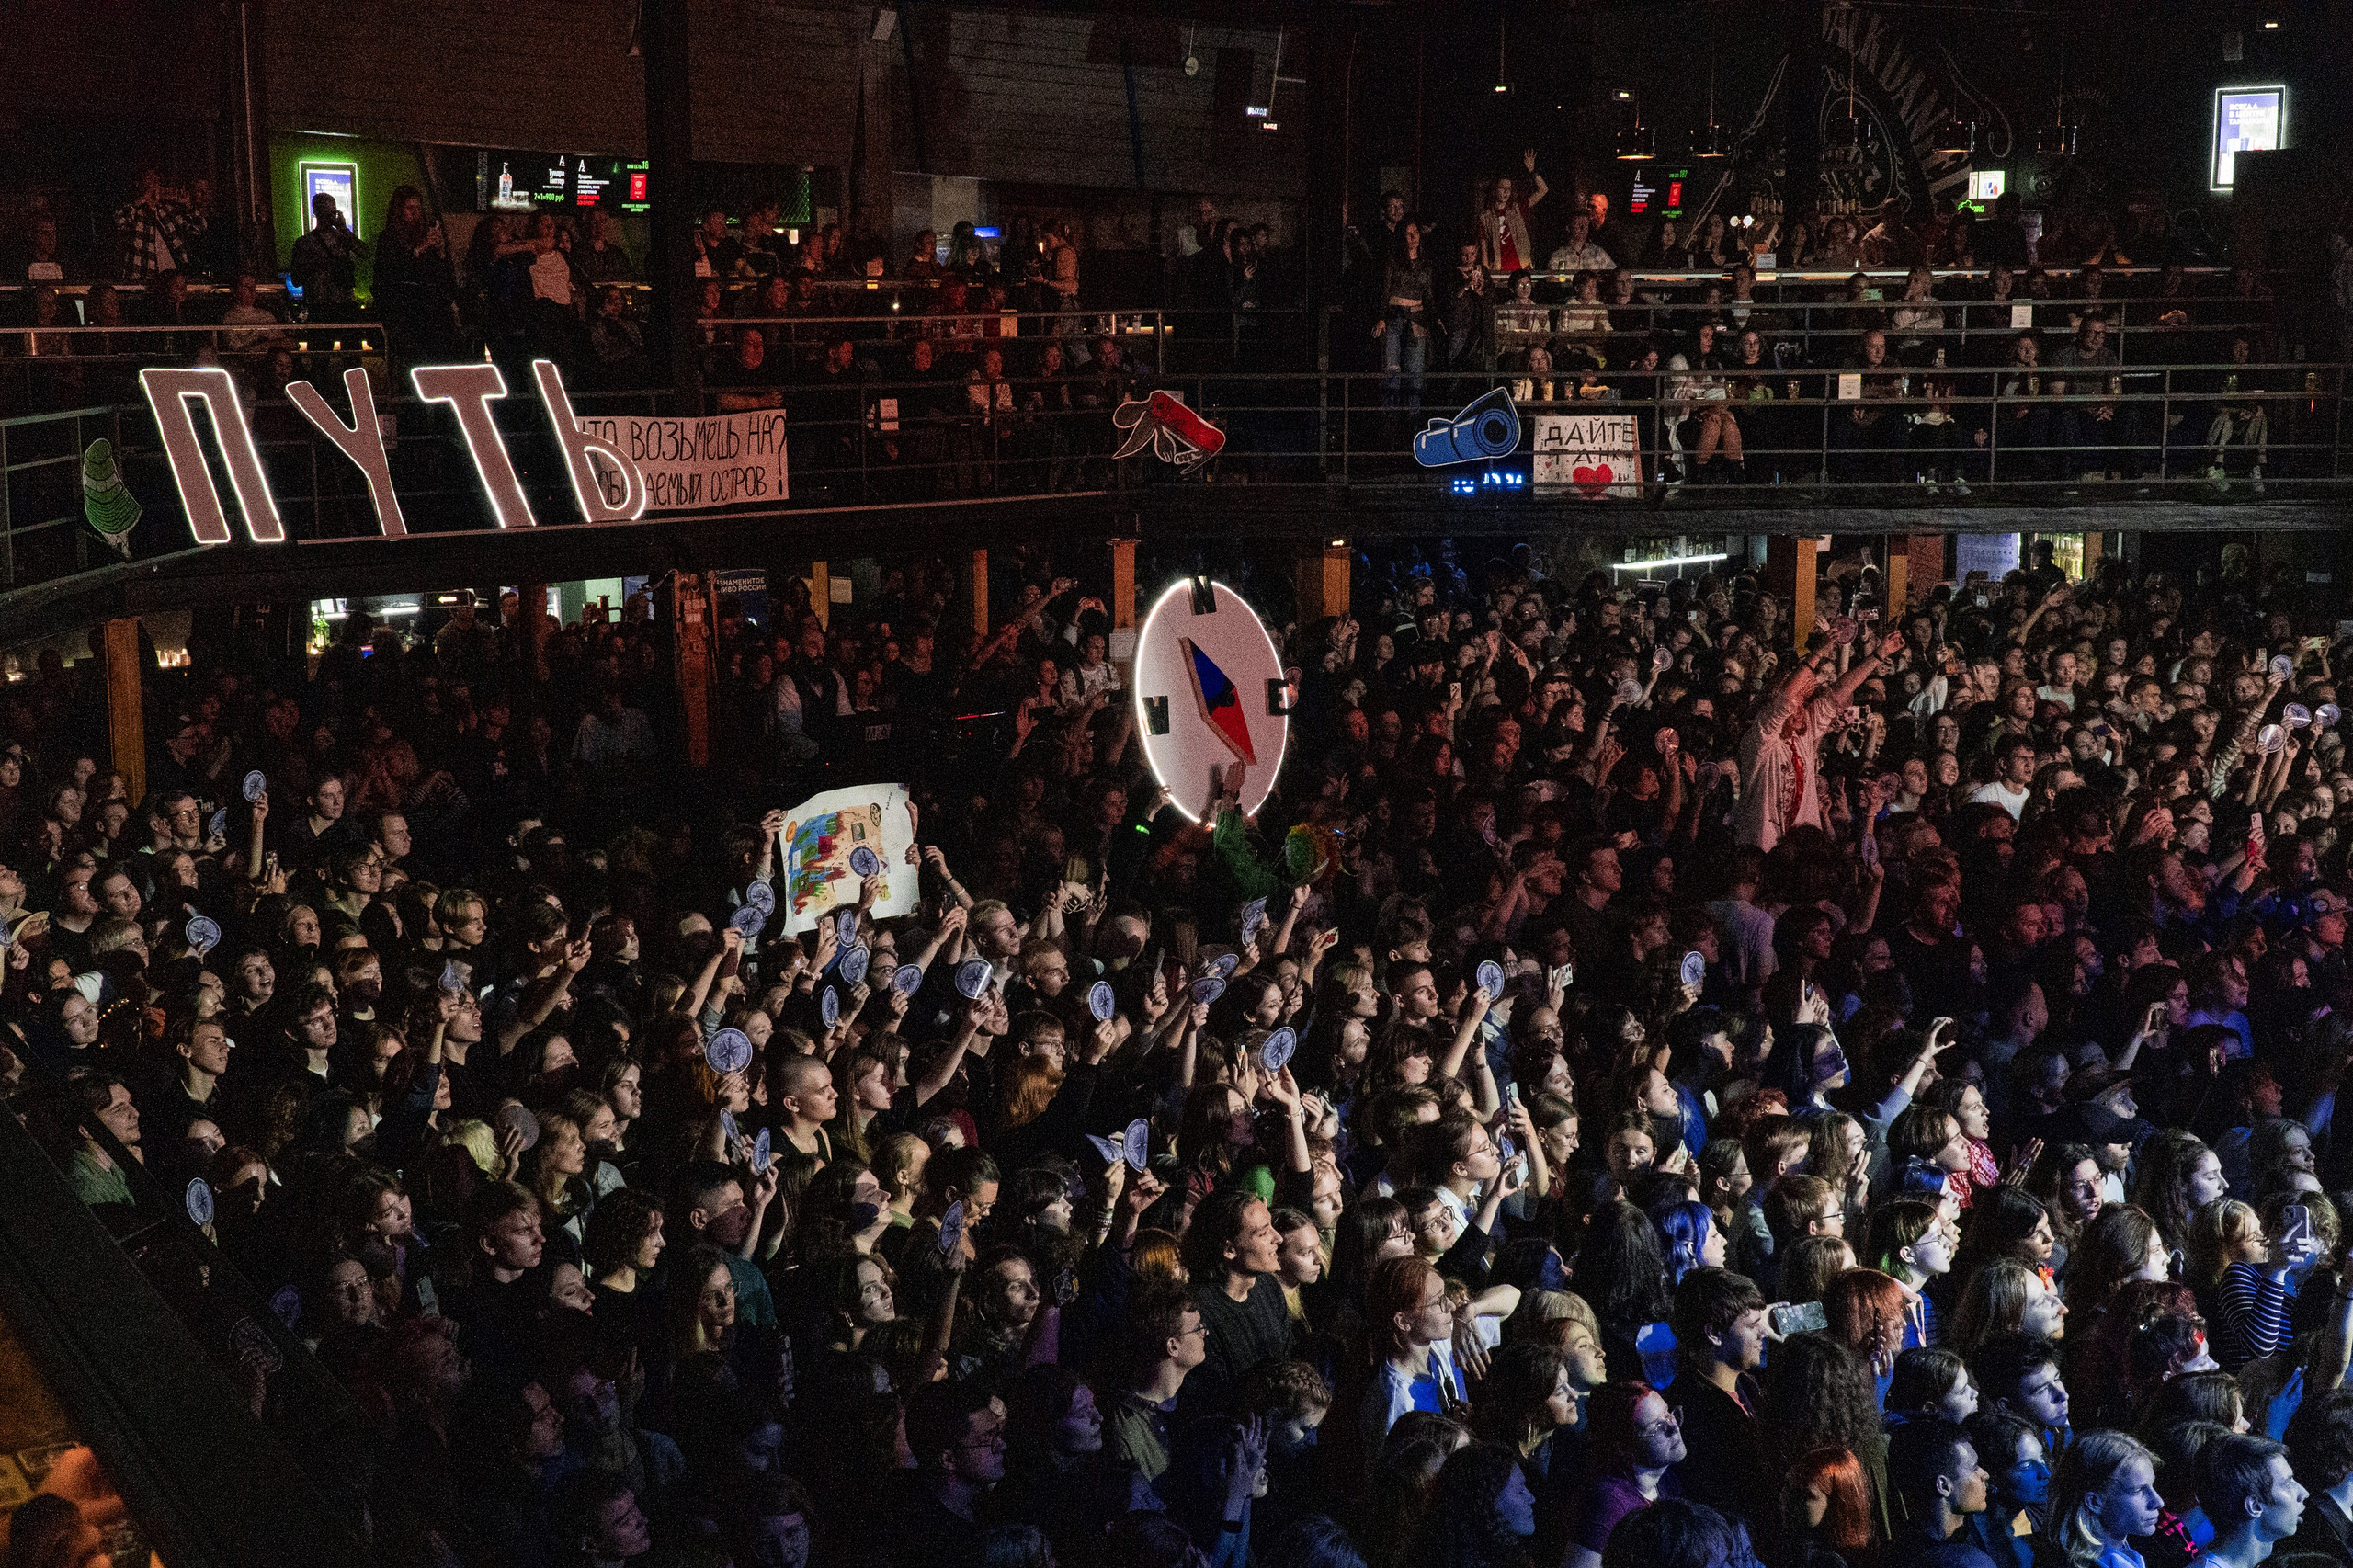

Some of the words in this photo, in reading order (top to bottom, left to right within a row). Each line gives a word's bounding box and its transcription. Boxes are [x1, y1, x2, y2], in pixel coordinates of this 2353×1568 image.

[139, 359, 646, 544] ПУТЬ
[1544, 417, 1636, 448] ДАЙТЕ
[719, 577, 765, 586] ЗНАМЕНИТОЕ
[1188, 575, 1217, 616] N
[1265, 677, 1290, 717] E
